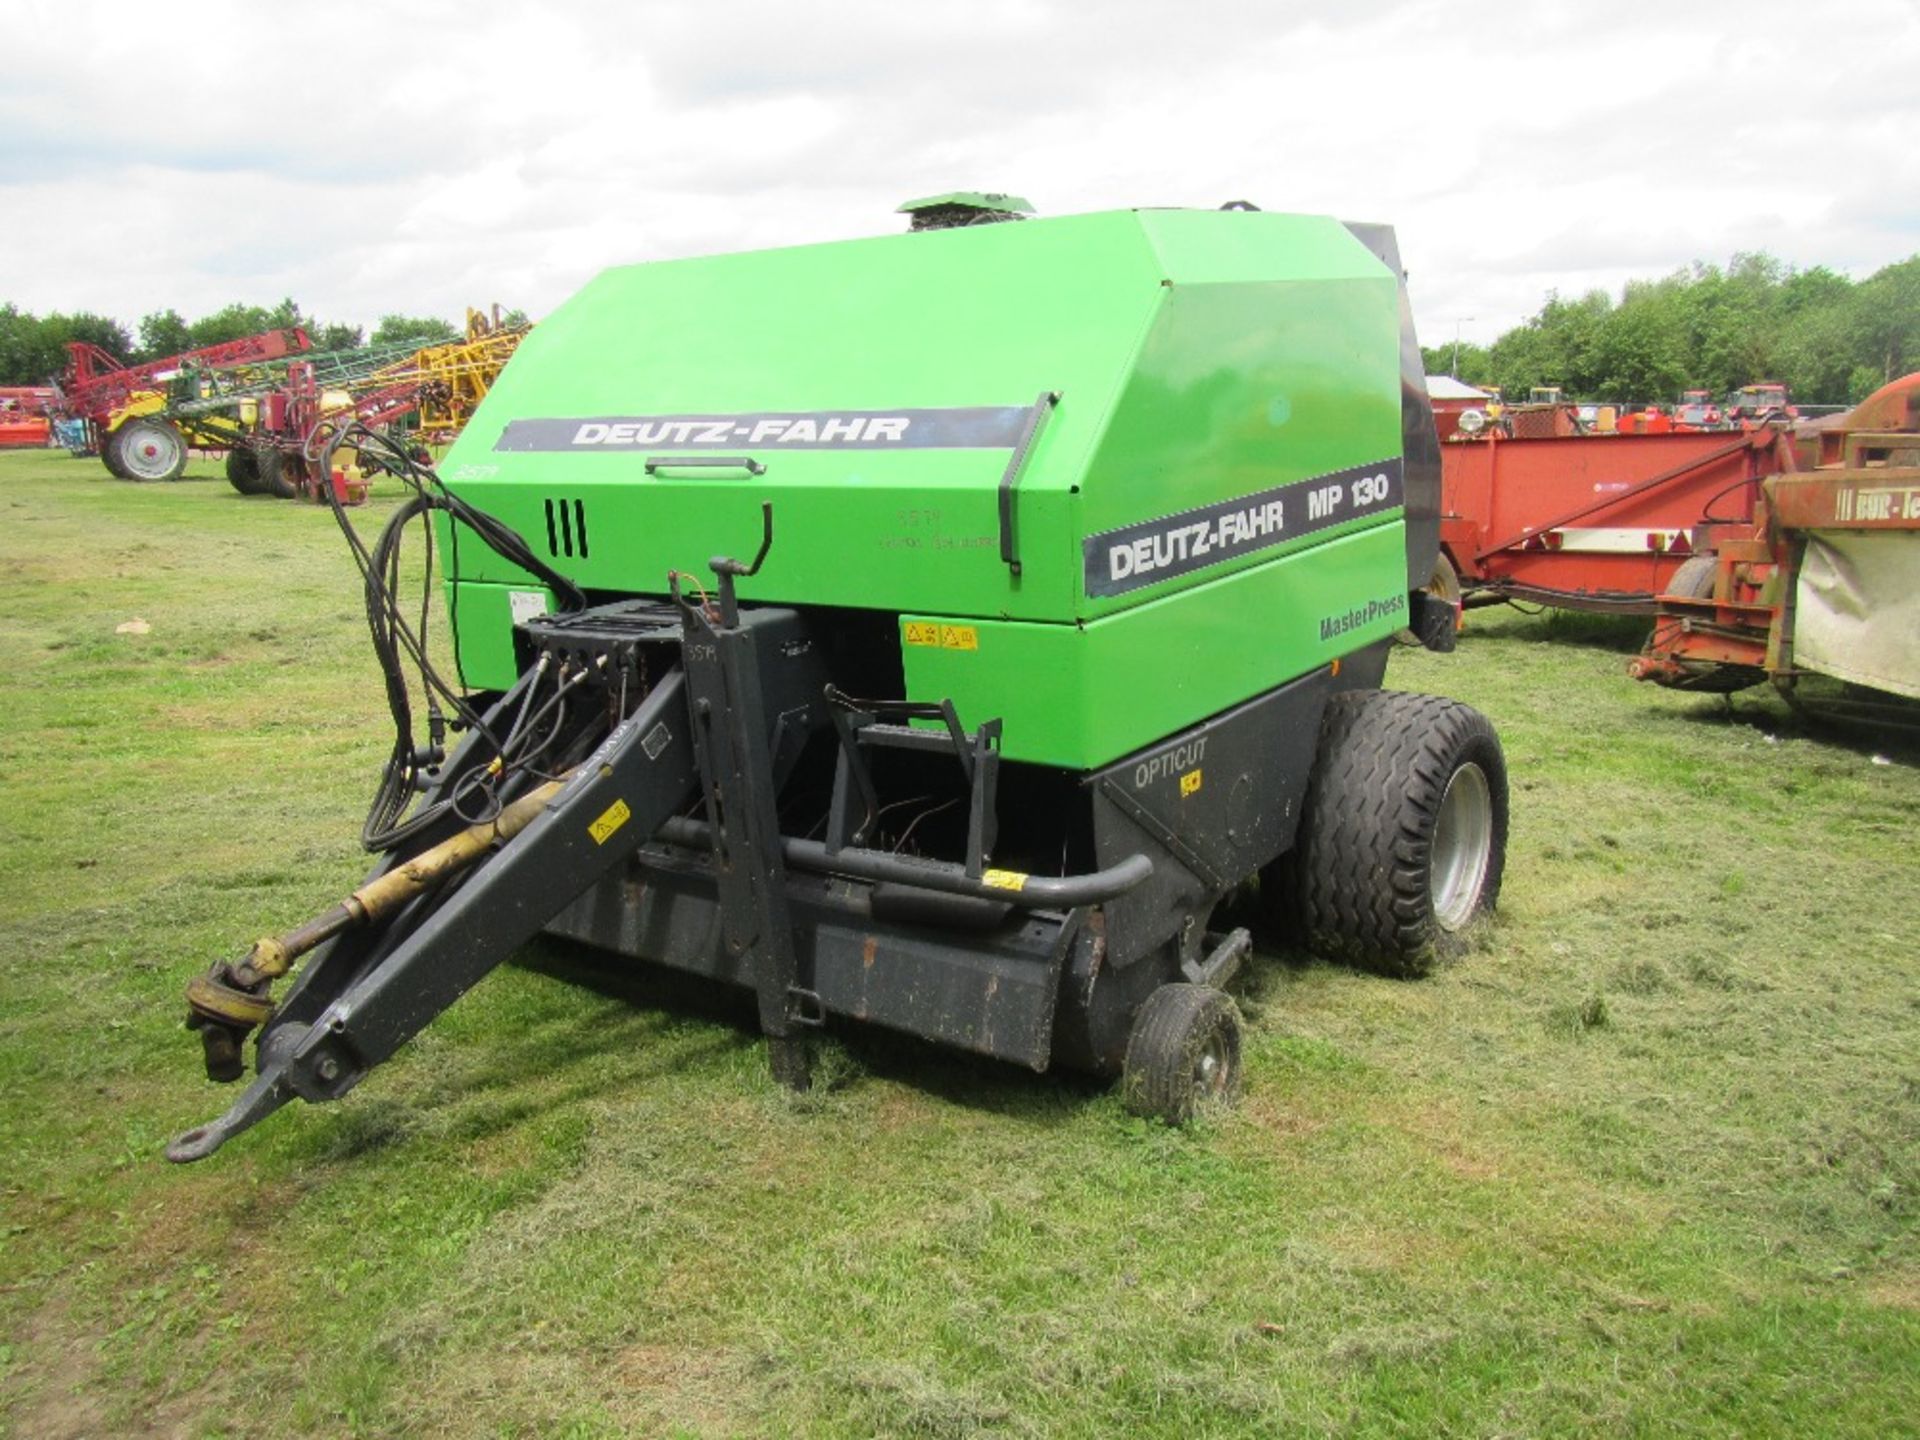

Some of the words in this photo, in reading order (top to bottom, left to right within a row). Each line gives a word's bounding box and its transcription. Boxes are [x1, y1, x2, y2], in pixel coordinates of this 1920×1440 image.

[571, 418, 911, 445] DEUTZ-FAHR
[1108, 500, 1284, 581] DEUTZ-FAHR
[1308, 484, 1343, 520] MP
[1351, 473, 1389, 507] 130
[1320, 594, 1405, 641] MasterPress
[1134, 737, 1208, 789] OPTICUT
